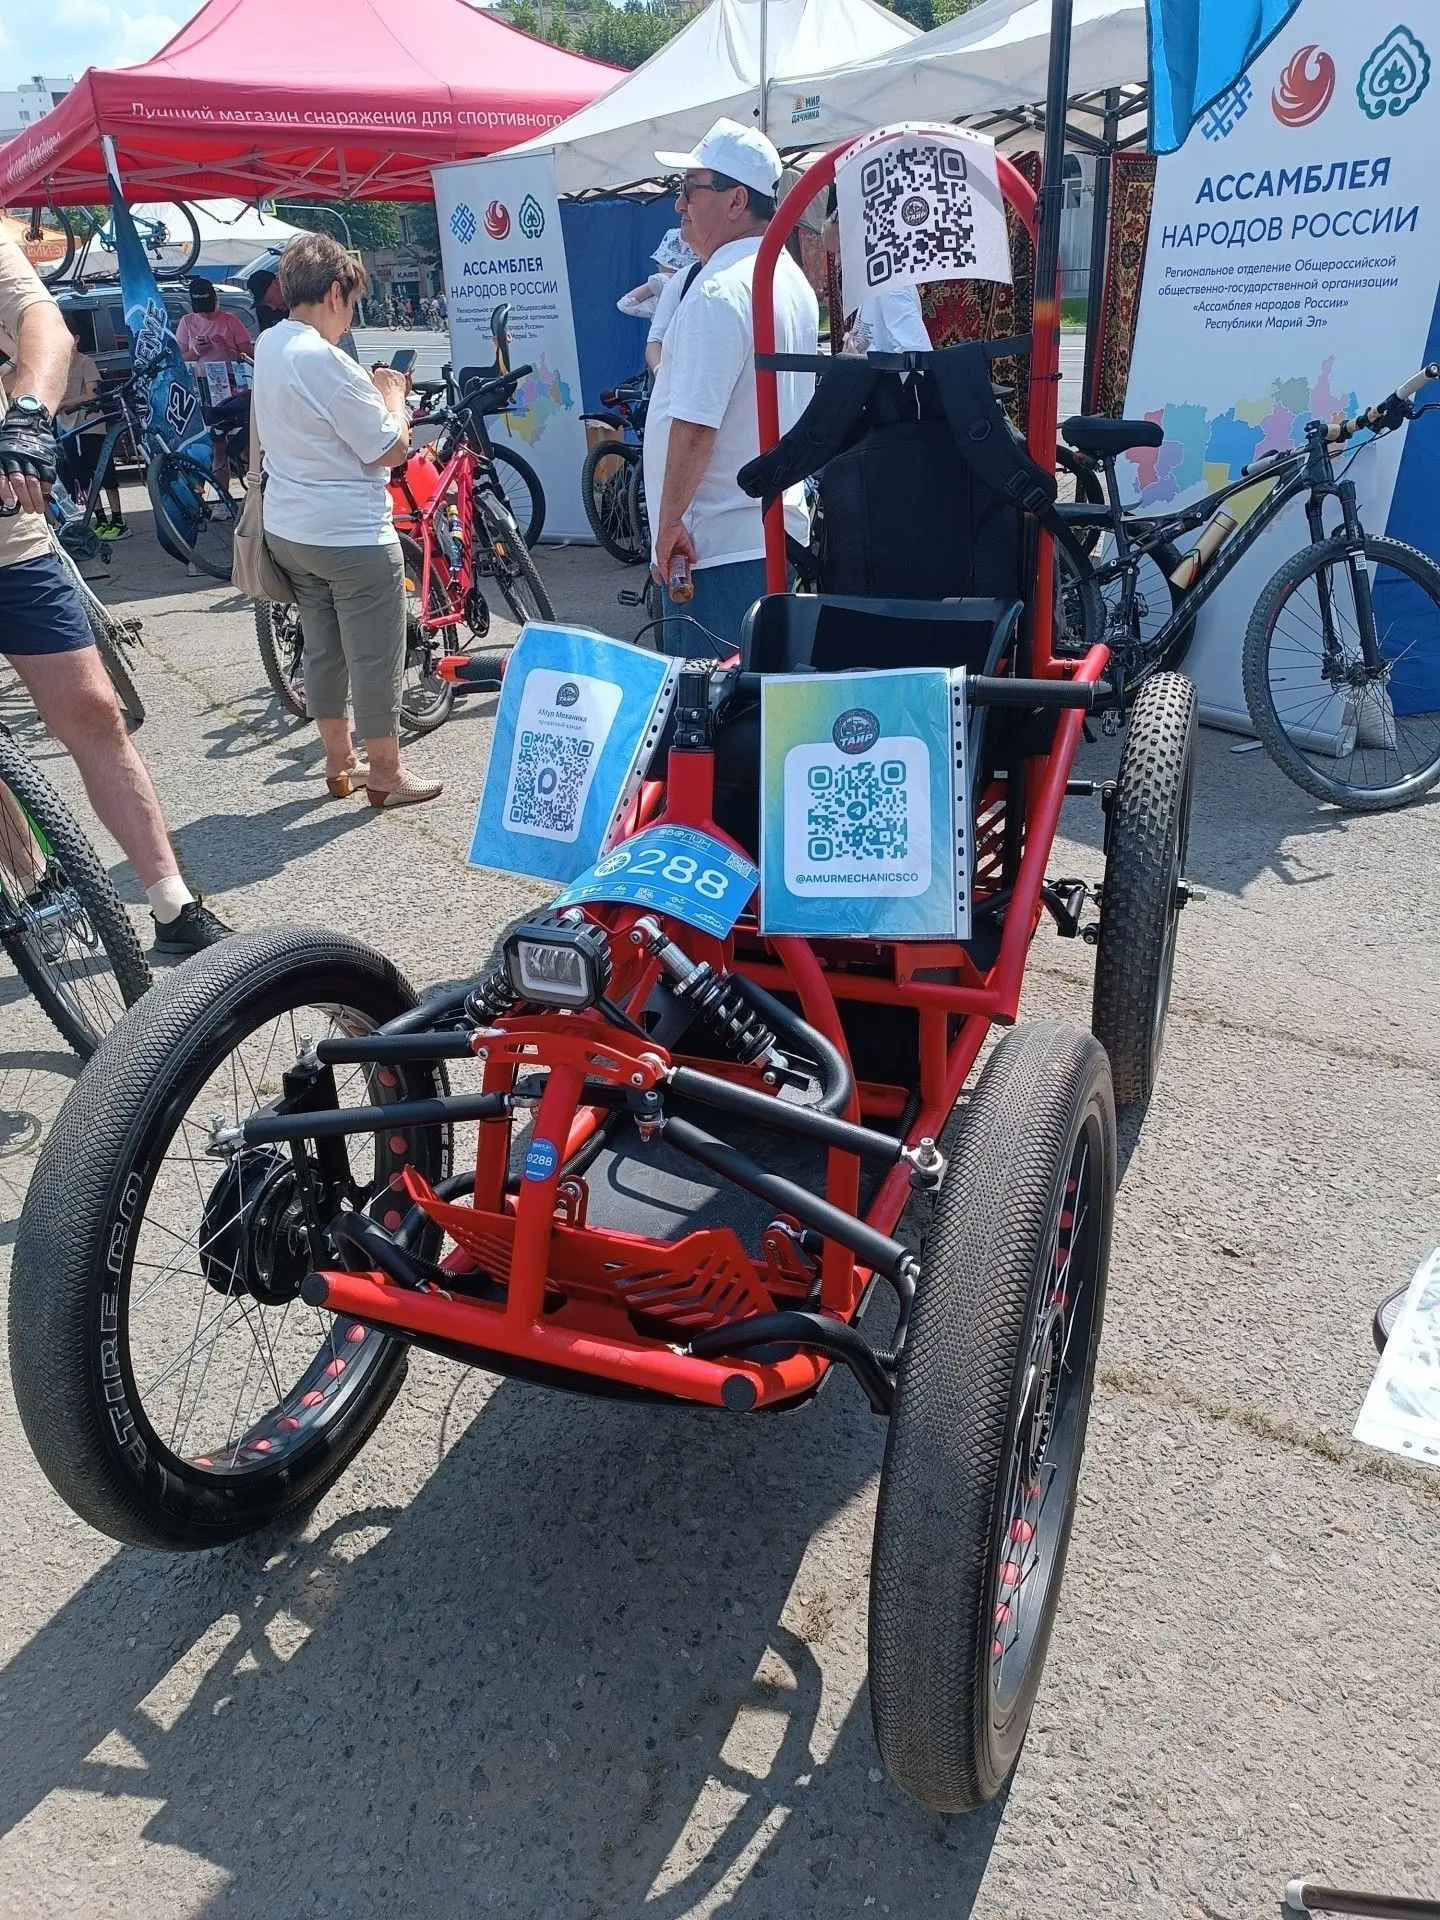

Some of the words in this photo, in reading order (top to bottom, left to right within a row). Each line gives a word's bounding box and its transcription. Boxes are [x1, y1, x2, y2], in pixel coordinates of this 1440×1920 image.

[805, 95, 821, 108] МИР
[220, 109, 300, 124] магазин
[304, 110, 416, 127] снаряжения
[421, 110, 453, 127] для
[457, 110, 563, 129] спортивного
[1195, 156, 1392, 204] АССАМБЛЕЯ
[1161, 216, 1283, 249] НАРОДОВ
[1291, 205, 1419, 240] РОССИИ
[463, 257, 543, 276] АССАМБЛЕЯ
[1165, 266, 1234, 278] Региональное
[1237, 263, 1292, 275] отделение
[1294, 254, 1397, 273] Общероссийской
[450, 283, 508, 299] НАРОДОВ
[510, 280, 559, 296] РОССИИ
[1158, 278, 1319, 297] общественно-государственной
[1321, 276, 1399, 292] организации
[1192, 300, 1252, 312] «Ассамблея
[1255, 300, 1301, 312] народов
[1303, 297, 1349, 309] России»
[1205, 318, 1263, 332] Республики
[1265, 316, 1303, 330] Марий
[1305, 316, 1328, 328] Эл»
[165, 381, 197, 436] 12
[555, 711, 588, 723] Механика
[795, 872, 919, 885] @AMURMECHANICSCO
